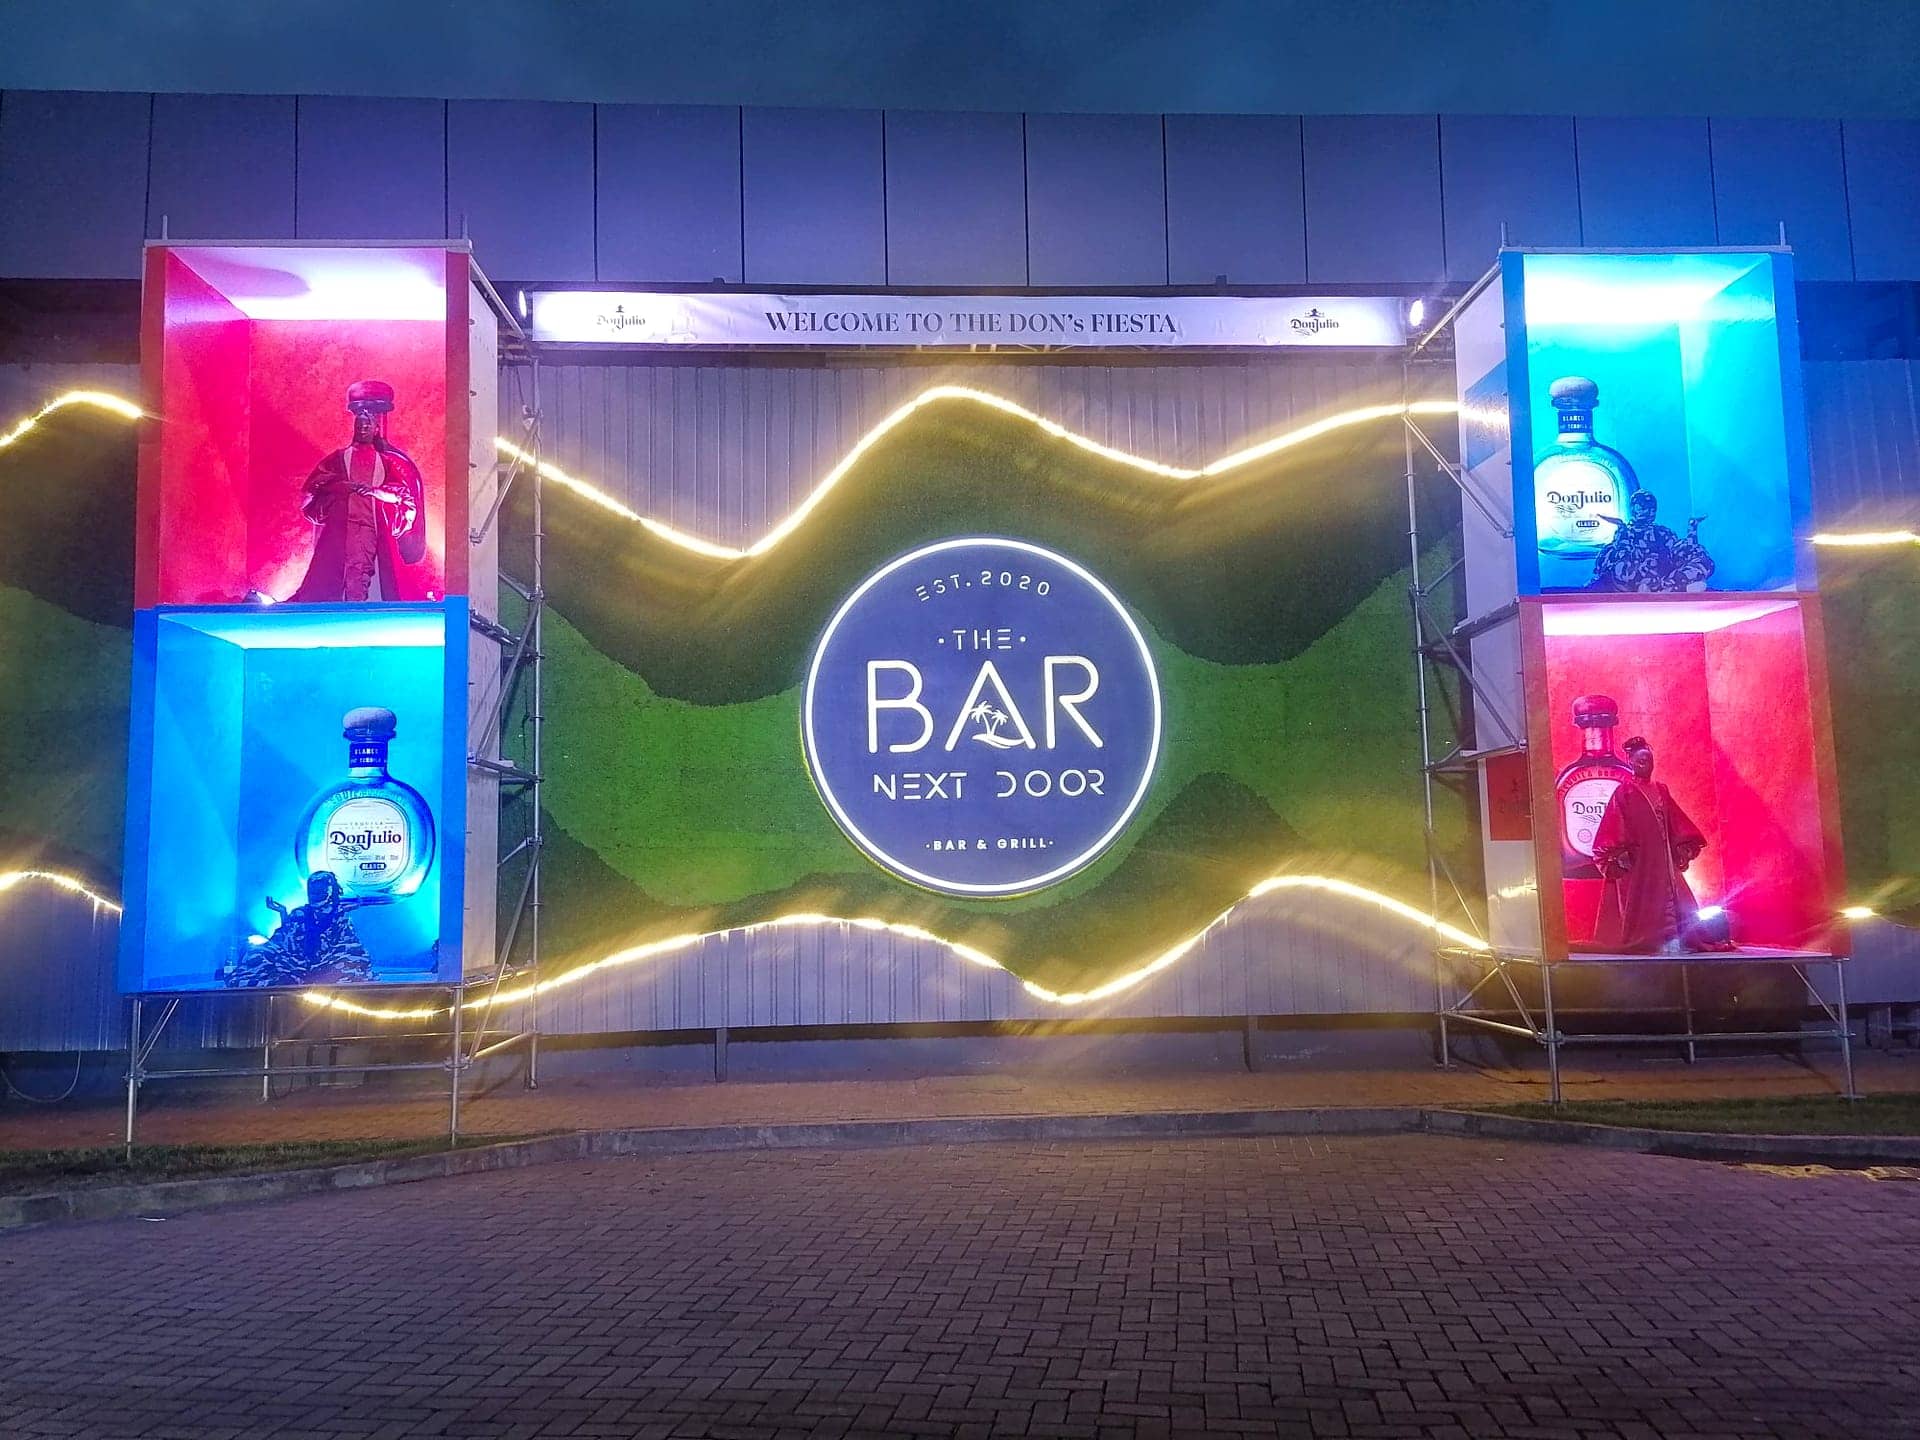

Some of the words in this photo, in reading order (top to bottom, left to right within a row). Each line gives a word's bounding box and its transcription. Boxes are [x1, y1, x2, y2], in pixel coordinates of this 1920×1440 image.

[765, 312, 899, 332] WELCOME
[905, 312, 943, 332] TO
[950, 313, 1002, 332] THE
[1009, 313, 1084, 333] DON's
[1091, 313, 1176, 333] FIESTA
[866, 655, 1104, 754] BAR
[873, 772, 968, 801] NEXT
[996, 769, 1105, 798] DOOR
[933, 839, 967, 851] BAR
[976, 839, 988, 850] &
[997, 837, 1047, 849] GRILL
